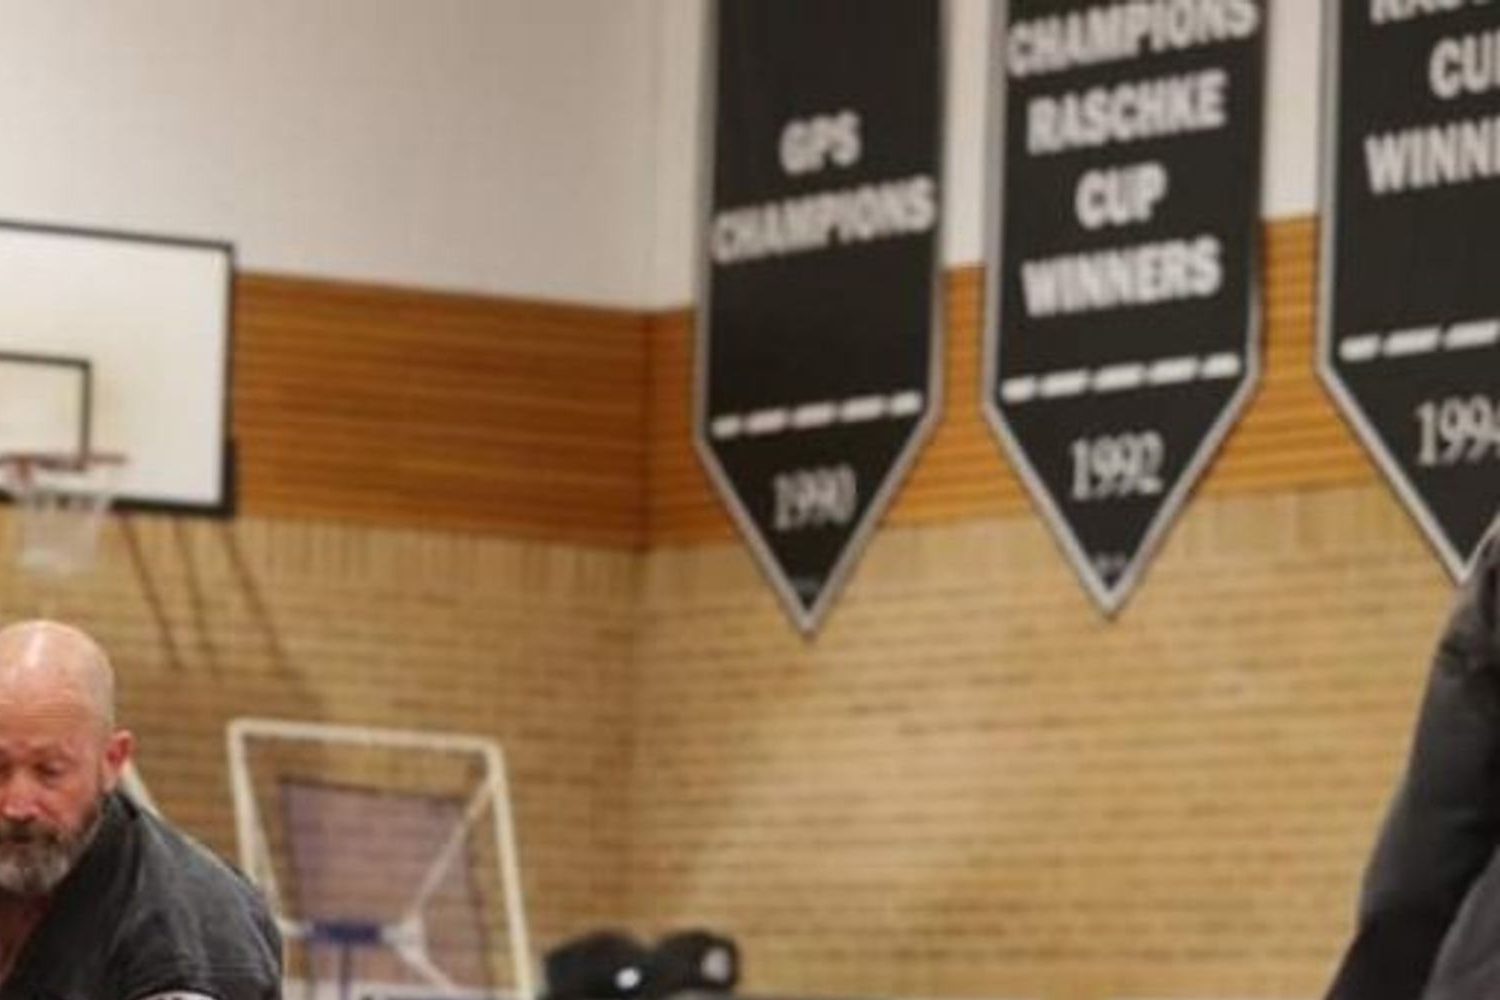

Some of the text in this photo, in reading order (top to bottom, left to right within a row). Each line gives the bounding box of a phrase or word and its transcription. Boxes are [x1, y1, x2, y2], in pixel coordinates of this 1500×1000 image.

[1007, 0, 1258, 76] CHAMPIONS
[1429, 29, 1500, 99] CU
[779, 110, 861, 174] GPS
[1027, 68, 1227, 156] RASCHKE
[1363, 116, 1500, 195] WINN
[711, 174, 936, 264] CHAMPIONS
[1074, 161, 1167, 230] CUP
[1021, 234, 1223, 318] WINNERS
[1069, 430, 1165, 500] 1992
